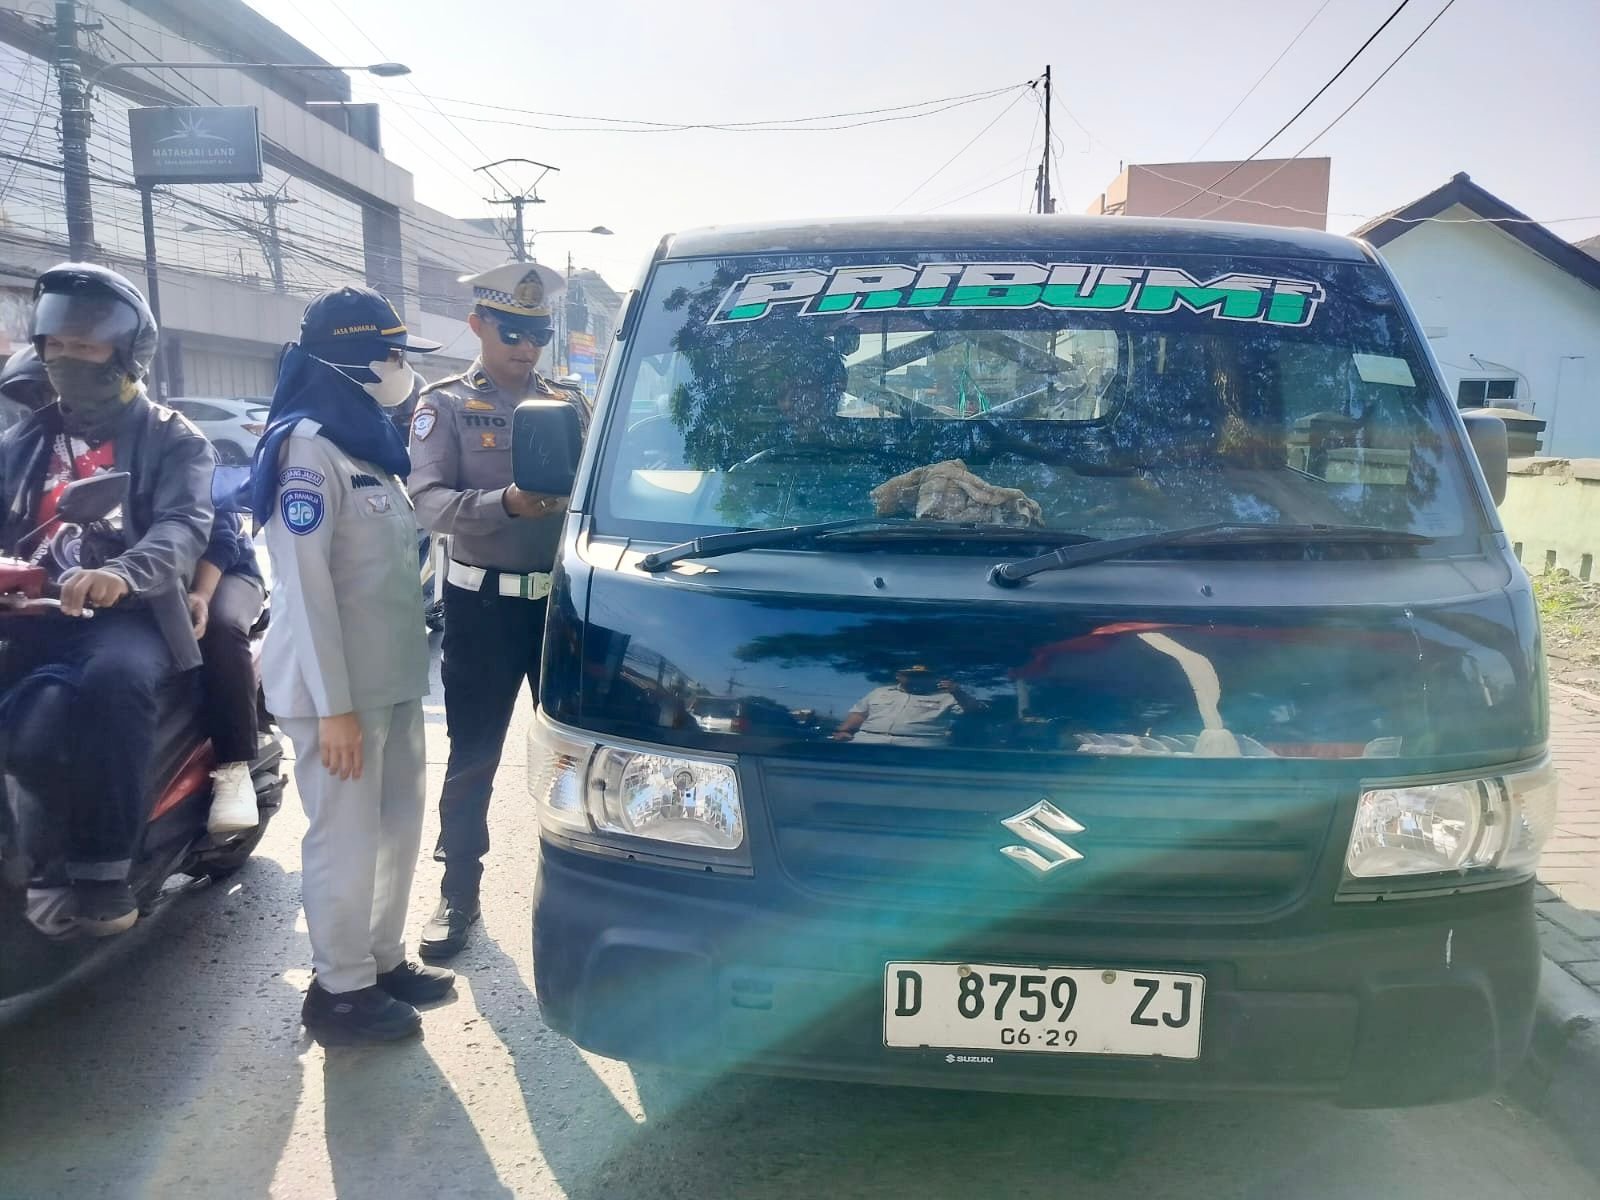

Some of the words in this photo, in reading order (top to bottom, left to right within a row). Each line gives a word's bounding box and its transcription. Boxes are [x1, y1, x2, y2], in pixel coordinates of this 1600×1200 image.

[207, 147, 235, 156] LAND
[463, 415, 506, 427] TITO
[895, 970, 922, 1017] D
[957, 972, 1077, 1023] 8759
[1130, 978, 1192, 1029] ZJ
[956, 1055, 994, 1063] SUZUKI
